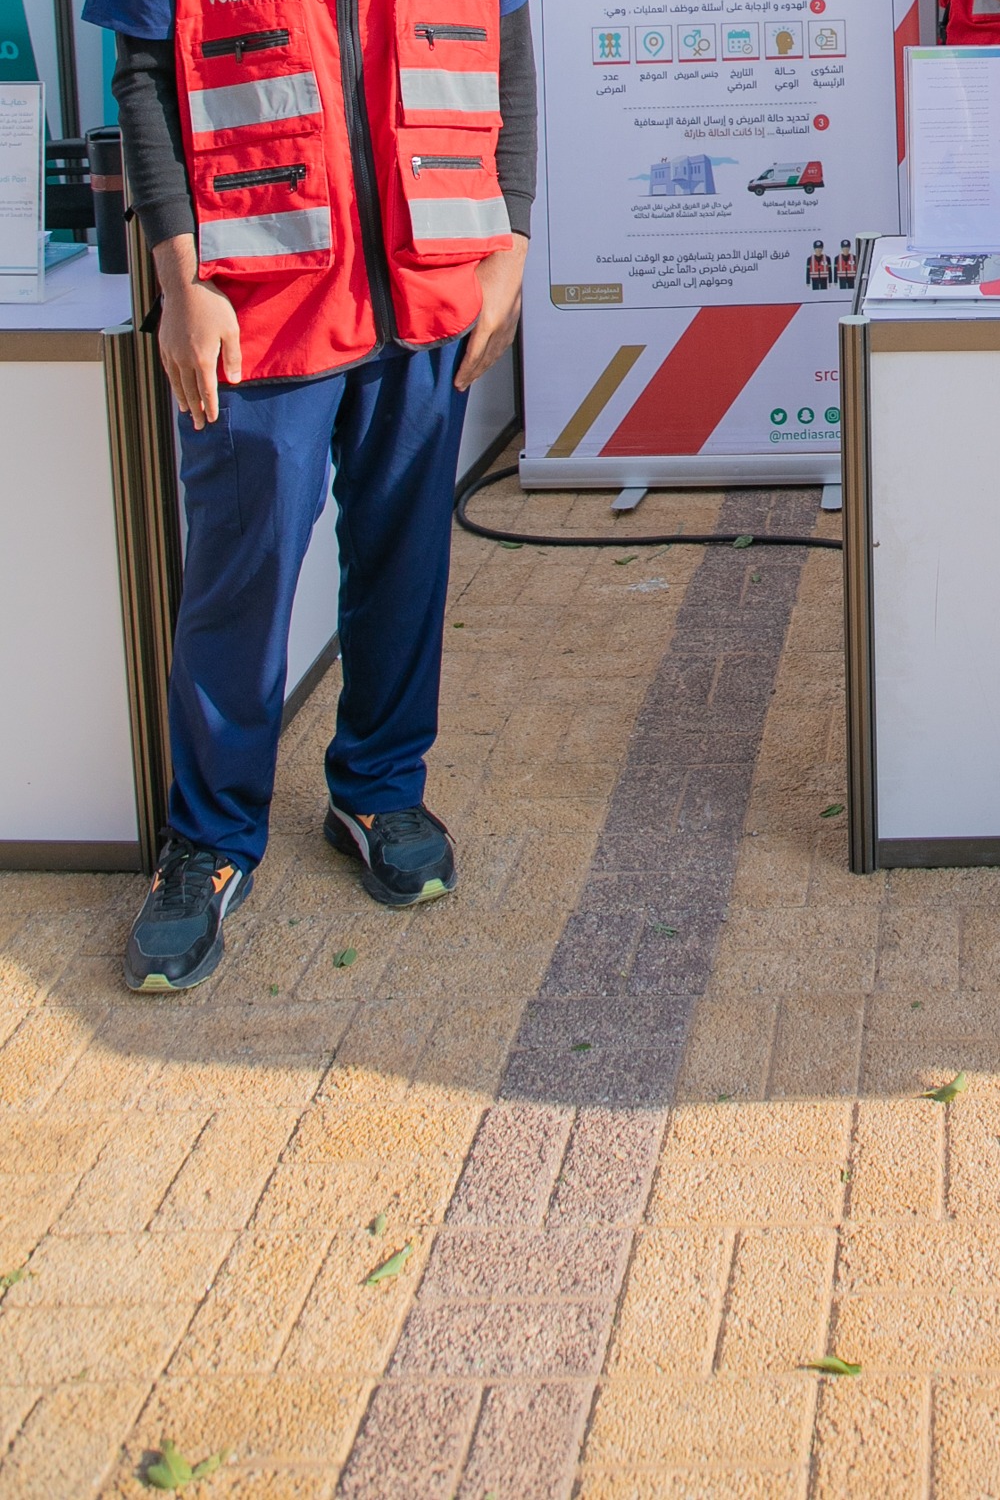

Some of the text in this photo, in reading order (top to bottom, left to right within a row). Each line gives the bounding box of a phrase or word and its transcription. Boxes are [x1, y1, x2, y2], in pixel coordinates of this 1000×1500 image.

[633, 5, 668, 14] العمليات
[670, 3, 700, 14] موظف
[701, 1, 724, 12] أسئلة
[726, 4, 743, 13] على
[746, 3, 771, 12] الإجابة
[780, 2, 808, 12] الهدوء
[602, 72, 619, 81] عدد
[639, 71, 668, 82] الموقع
[674, 71, 719, 81] جنس المريض
[730, 68, 754, 79] التاريخ
[811, 65, 844, 77] الشكوى
[774, 79, 799, 91] الوعي
[813, 77, 845, 88] الرئيسية
[634, 118, 673, 129] الإسعافية
[675, 117, 702, 127] الفرقة
[703, 116, 726, 127] إرسال
[736, 115, 766, 126] المريض
[767, 114, 784, 123] حالة
[786, 113, 810, 123] تحديد
[684, 127, 765, 139] إذا كانت الحالة طارئة
[596, 250, 790, 264] فريق الهلال الأحمر يتسابقون مع الوقت لمساعدة
[628, 266, 656, 277] تسهيل
[658, 266, 675, 275] على
[698, 264, 727, 275] فاحرص
[729, 264, 759, 274] المريض
[652, 277, 733, 289] وصولهم إلى المريض
